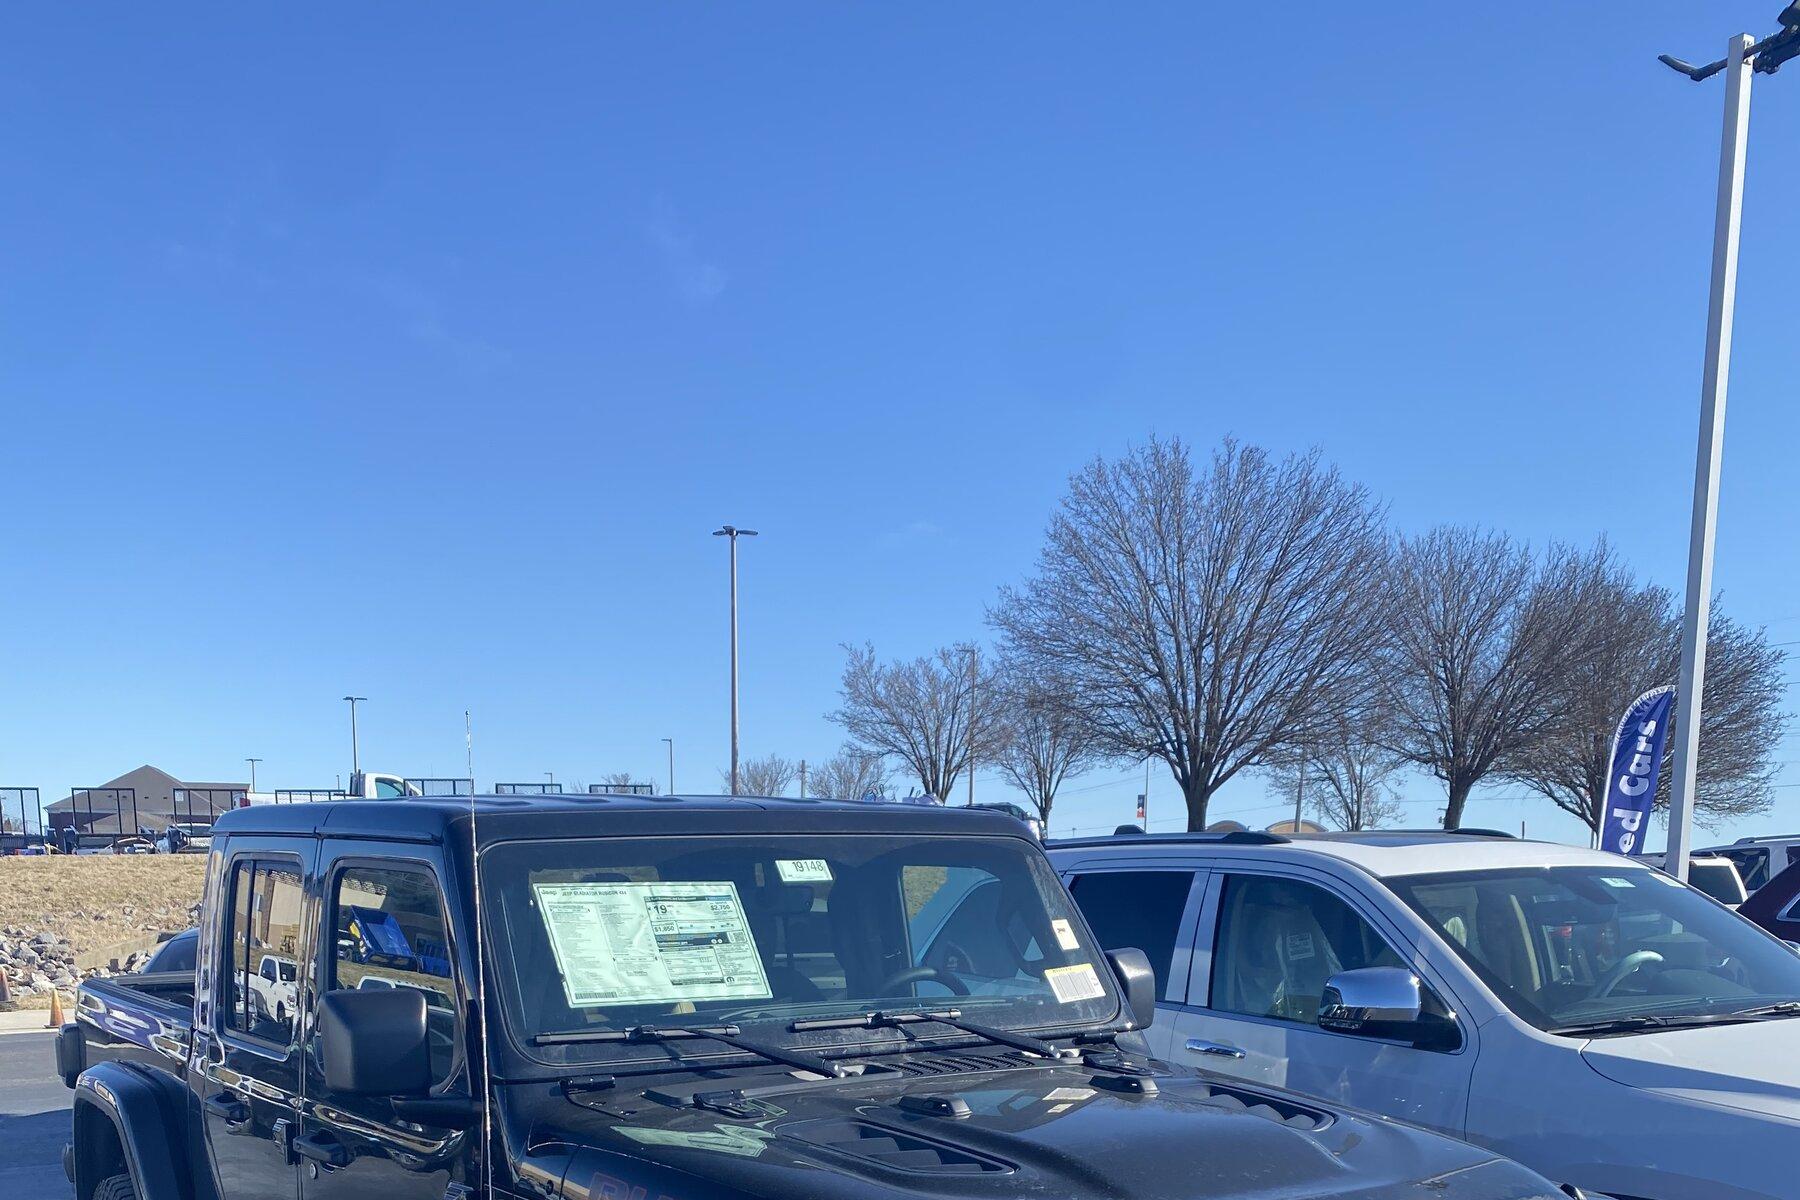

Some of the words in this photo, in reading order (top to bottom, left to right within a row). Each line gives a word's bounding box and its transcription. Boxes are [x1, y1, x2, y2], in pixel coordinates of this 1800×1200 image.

[1619, 719, 1657, 797] Cars
[791, 860, 824, 872] 19148
[653, 904, 668, 914] 19
